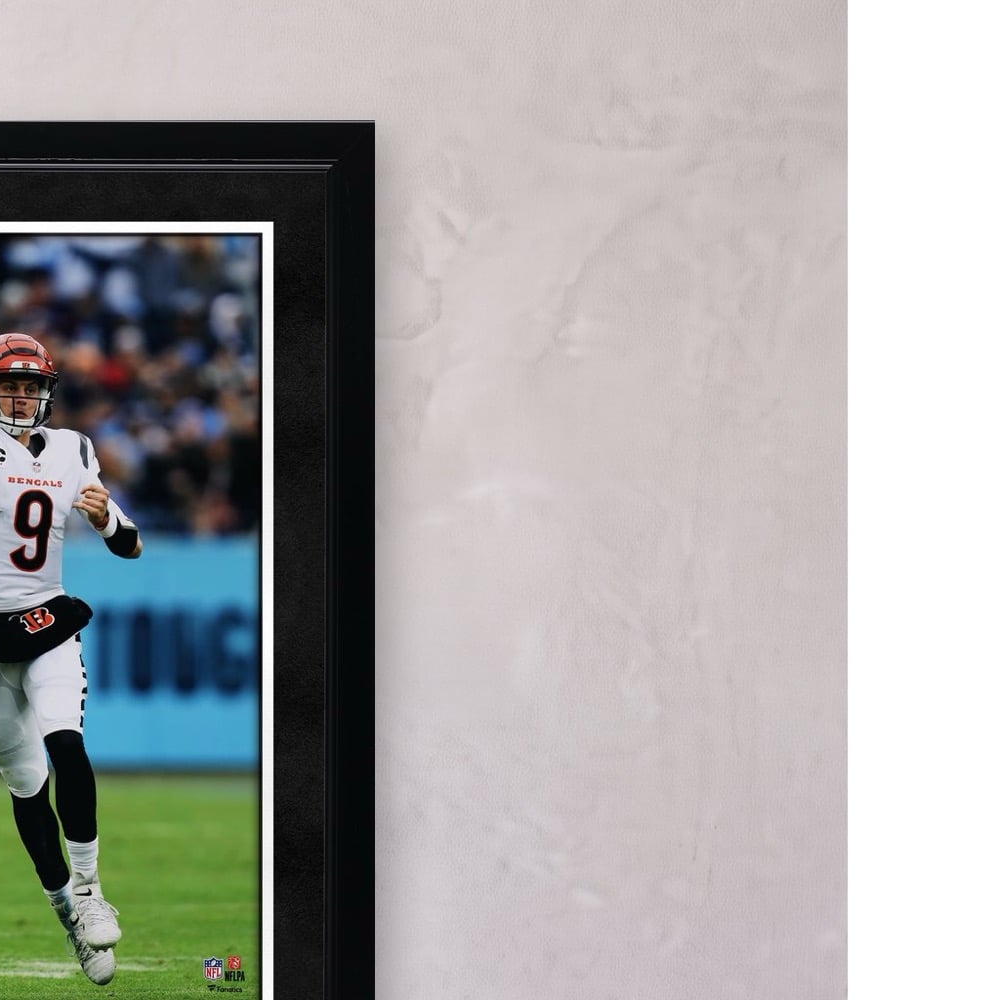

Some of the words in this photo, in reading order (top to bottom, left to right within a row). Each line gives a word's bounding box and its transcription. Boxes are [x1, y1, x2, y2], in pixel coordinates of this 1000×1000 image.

[8, 476, 62, 487] BENGALS
[10, 490, 53, 572] 9
[206, 968, 221, 978] NFL
[225, 971, 246, 981] NFLPA
